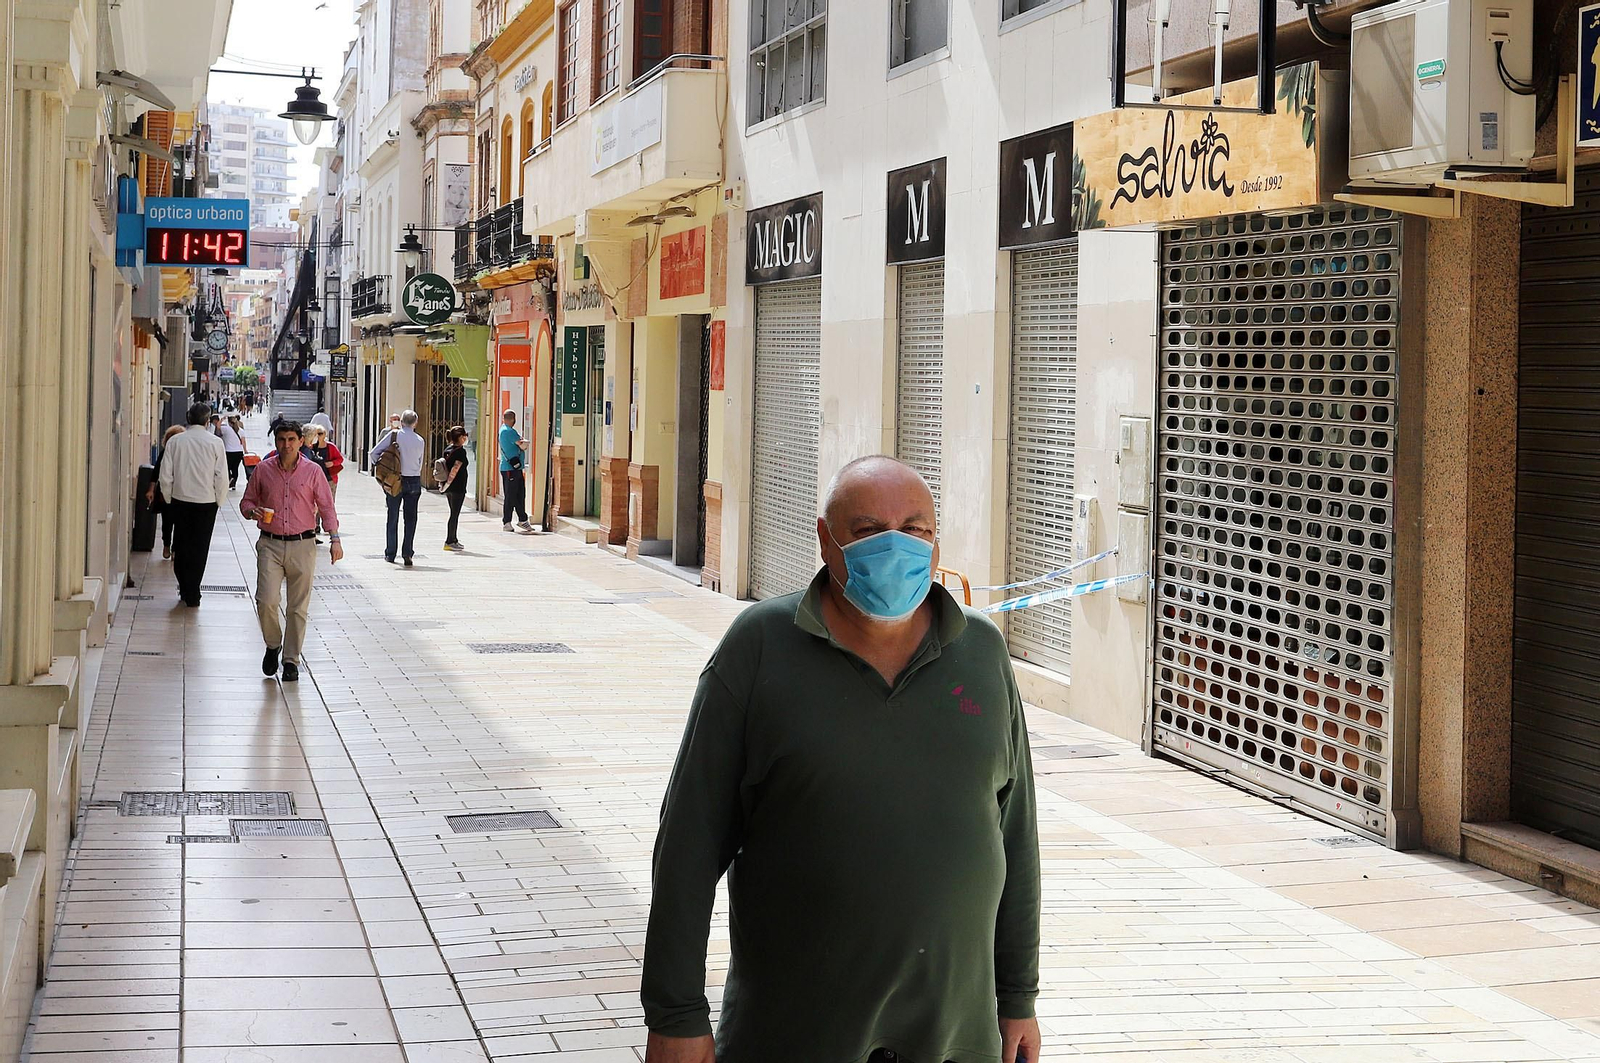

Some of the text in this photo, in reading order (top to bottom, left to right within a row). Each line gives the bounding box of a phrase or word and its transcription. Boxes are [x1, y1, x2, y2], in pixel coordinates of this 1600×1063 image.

[1021, 151, 1057, 229] M
[1109, 109, 1235, 210] salvia
[1240, 174, 1283, 194] Desde 1992
[197, 205, 244, 221] urbano
[753, 208, 817, 271] MAGIC
[904, 179, 931, 245] M
[161, 232, 243, 264] 11:42
[571, 331, 580, 408] Herbolario
